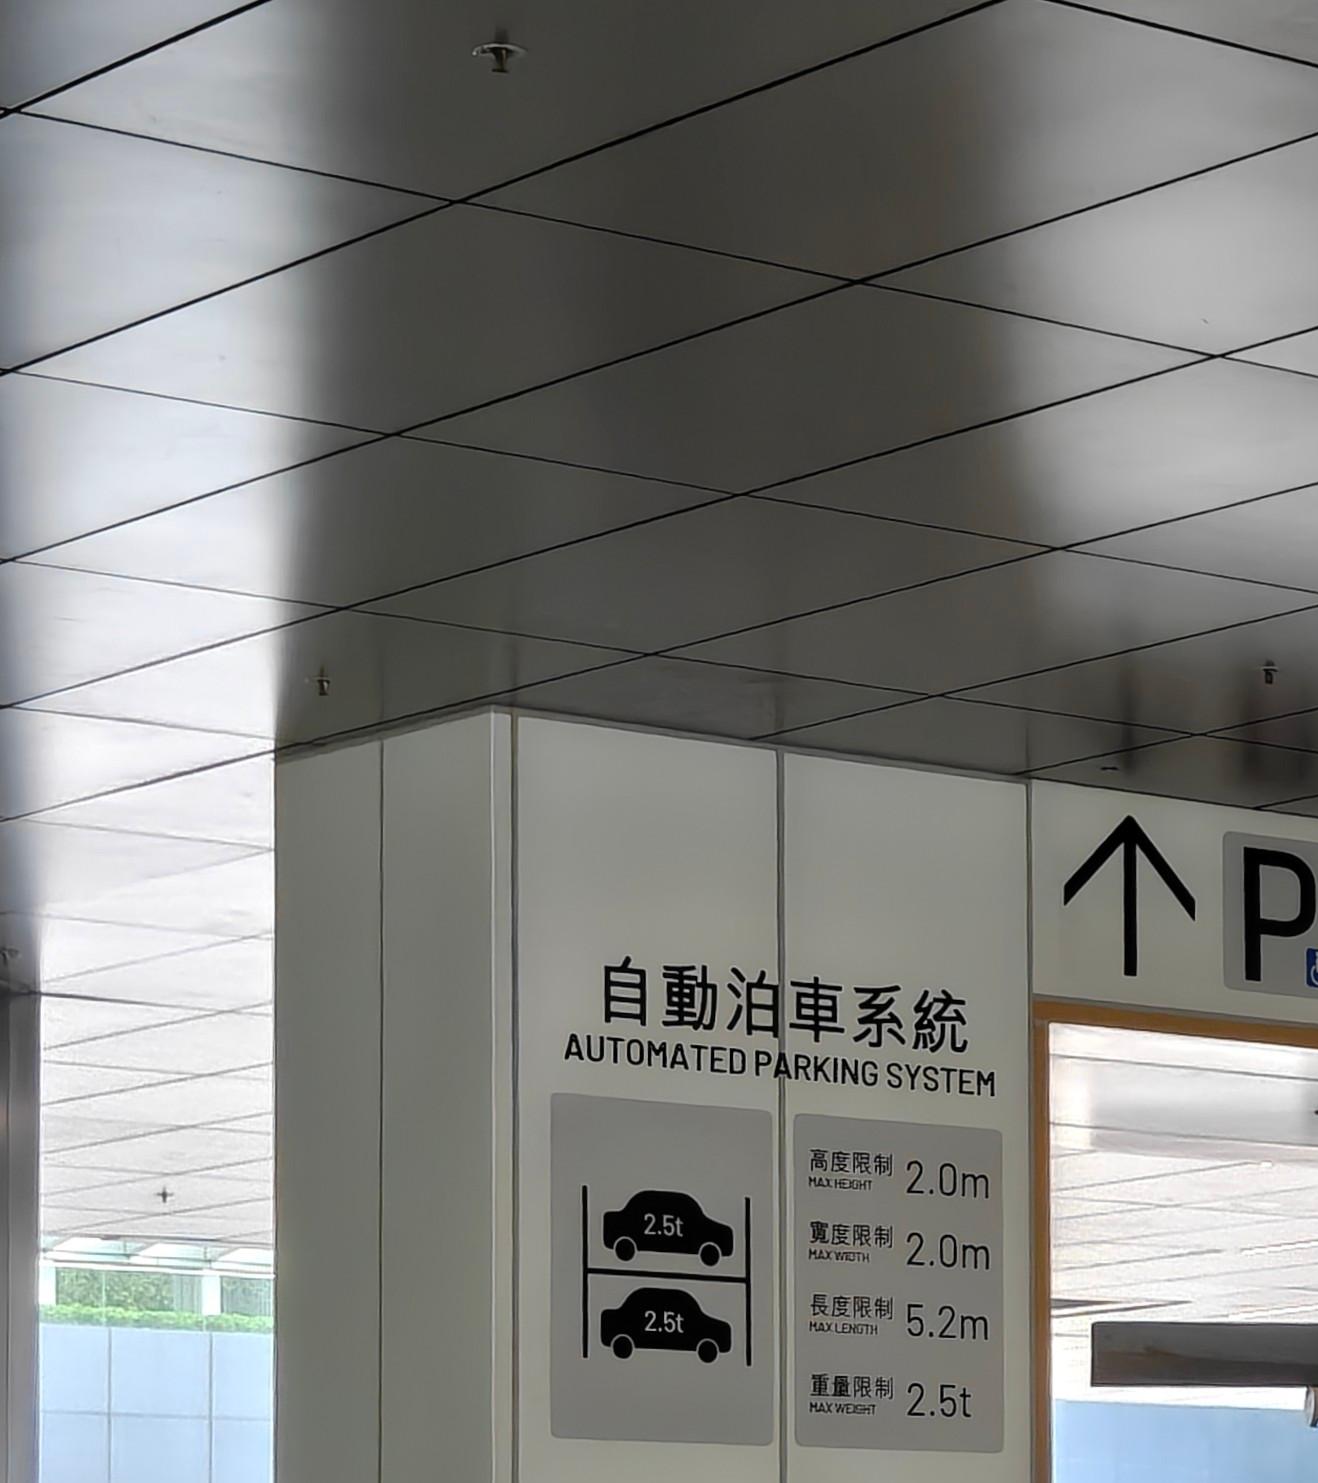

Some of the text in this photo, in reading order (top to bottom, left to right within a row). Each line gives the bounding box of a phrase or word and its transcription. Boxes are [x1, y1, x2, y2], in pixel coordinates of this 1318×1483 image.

[1243, 847, 1316, 981] P
[603, 956, 969, 1054] 自動泊車系統
[564, 1033, 996, 1097] AUTOMATED PARKING SYSTEM
[808, 1176, 872, 1191] MAX HEIGHT
[809, 1149, 989, 1199] 高度限制 2.0m
[644, 1213, 684, 1237] 2.5t
[809, 1221, 990, 1270] 寬度限制 2.0m
[808, 1248, 870, 1263] MAX WIDTH
[644, 1310, 684, 1333] 2.5t
[809, 1321, 878, 1336] MAX LENGTH
[810, 1294, 989, 1340] 長度限制 5.2m
[809, 1402, 832, 1414] MAX
[810, 1373, 972, 1417] 重量限制 2.5t
